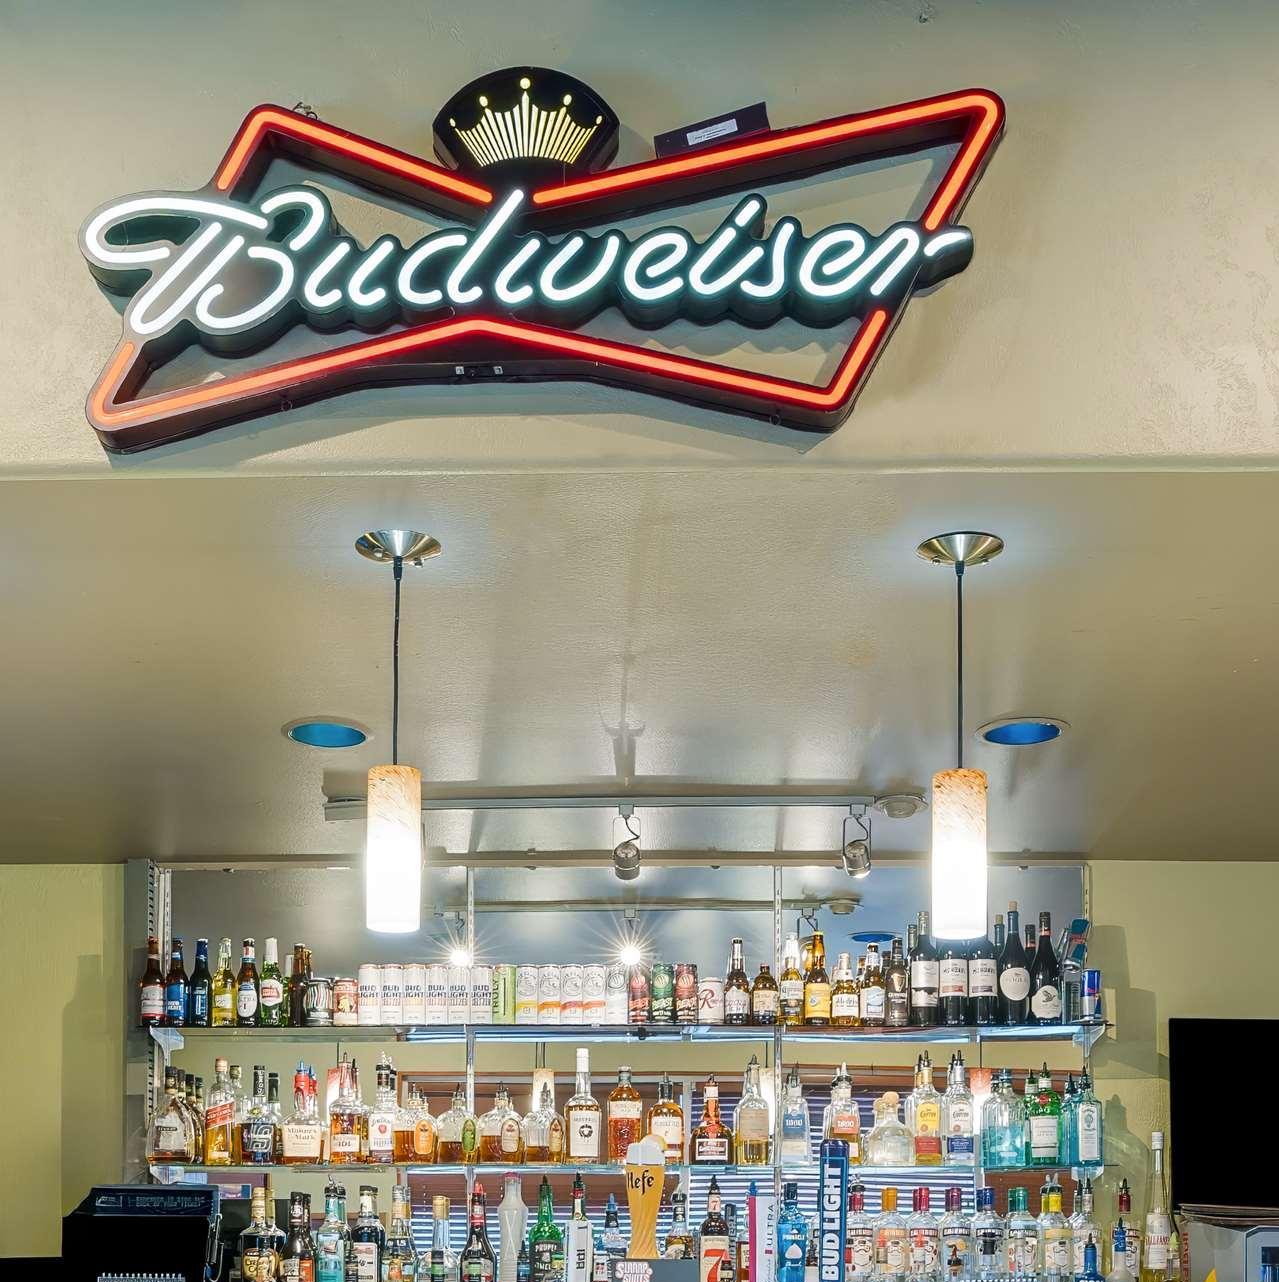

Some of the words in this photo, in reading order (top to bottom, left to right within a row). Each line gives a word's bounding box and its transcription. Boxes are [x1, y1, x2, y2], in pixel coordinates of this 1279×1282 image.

[82, 186, 974, 340] Budweiser
[822, 1163, 843, 1228] LIGHT
[766, 1204, 775, 1248] ULTRA
[575, 1248, 586, 1270] IPA
[821, 1232, 841, 1282] BUD
